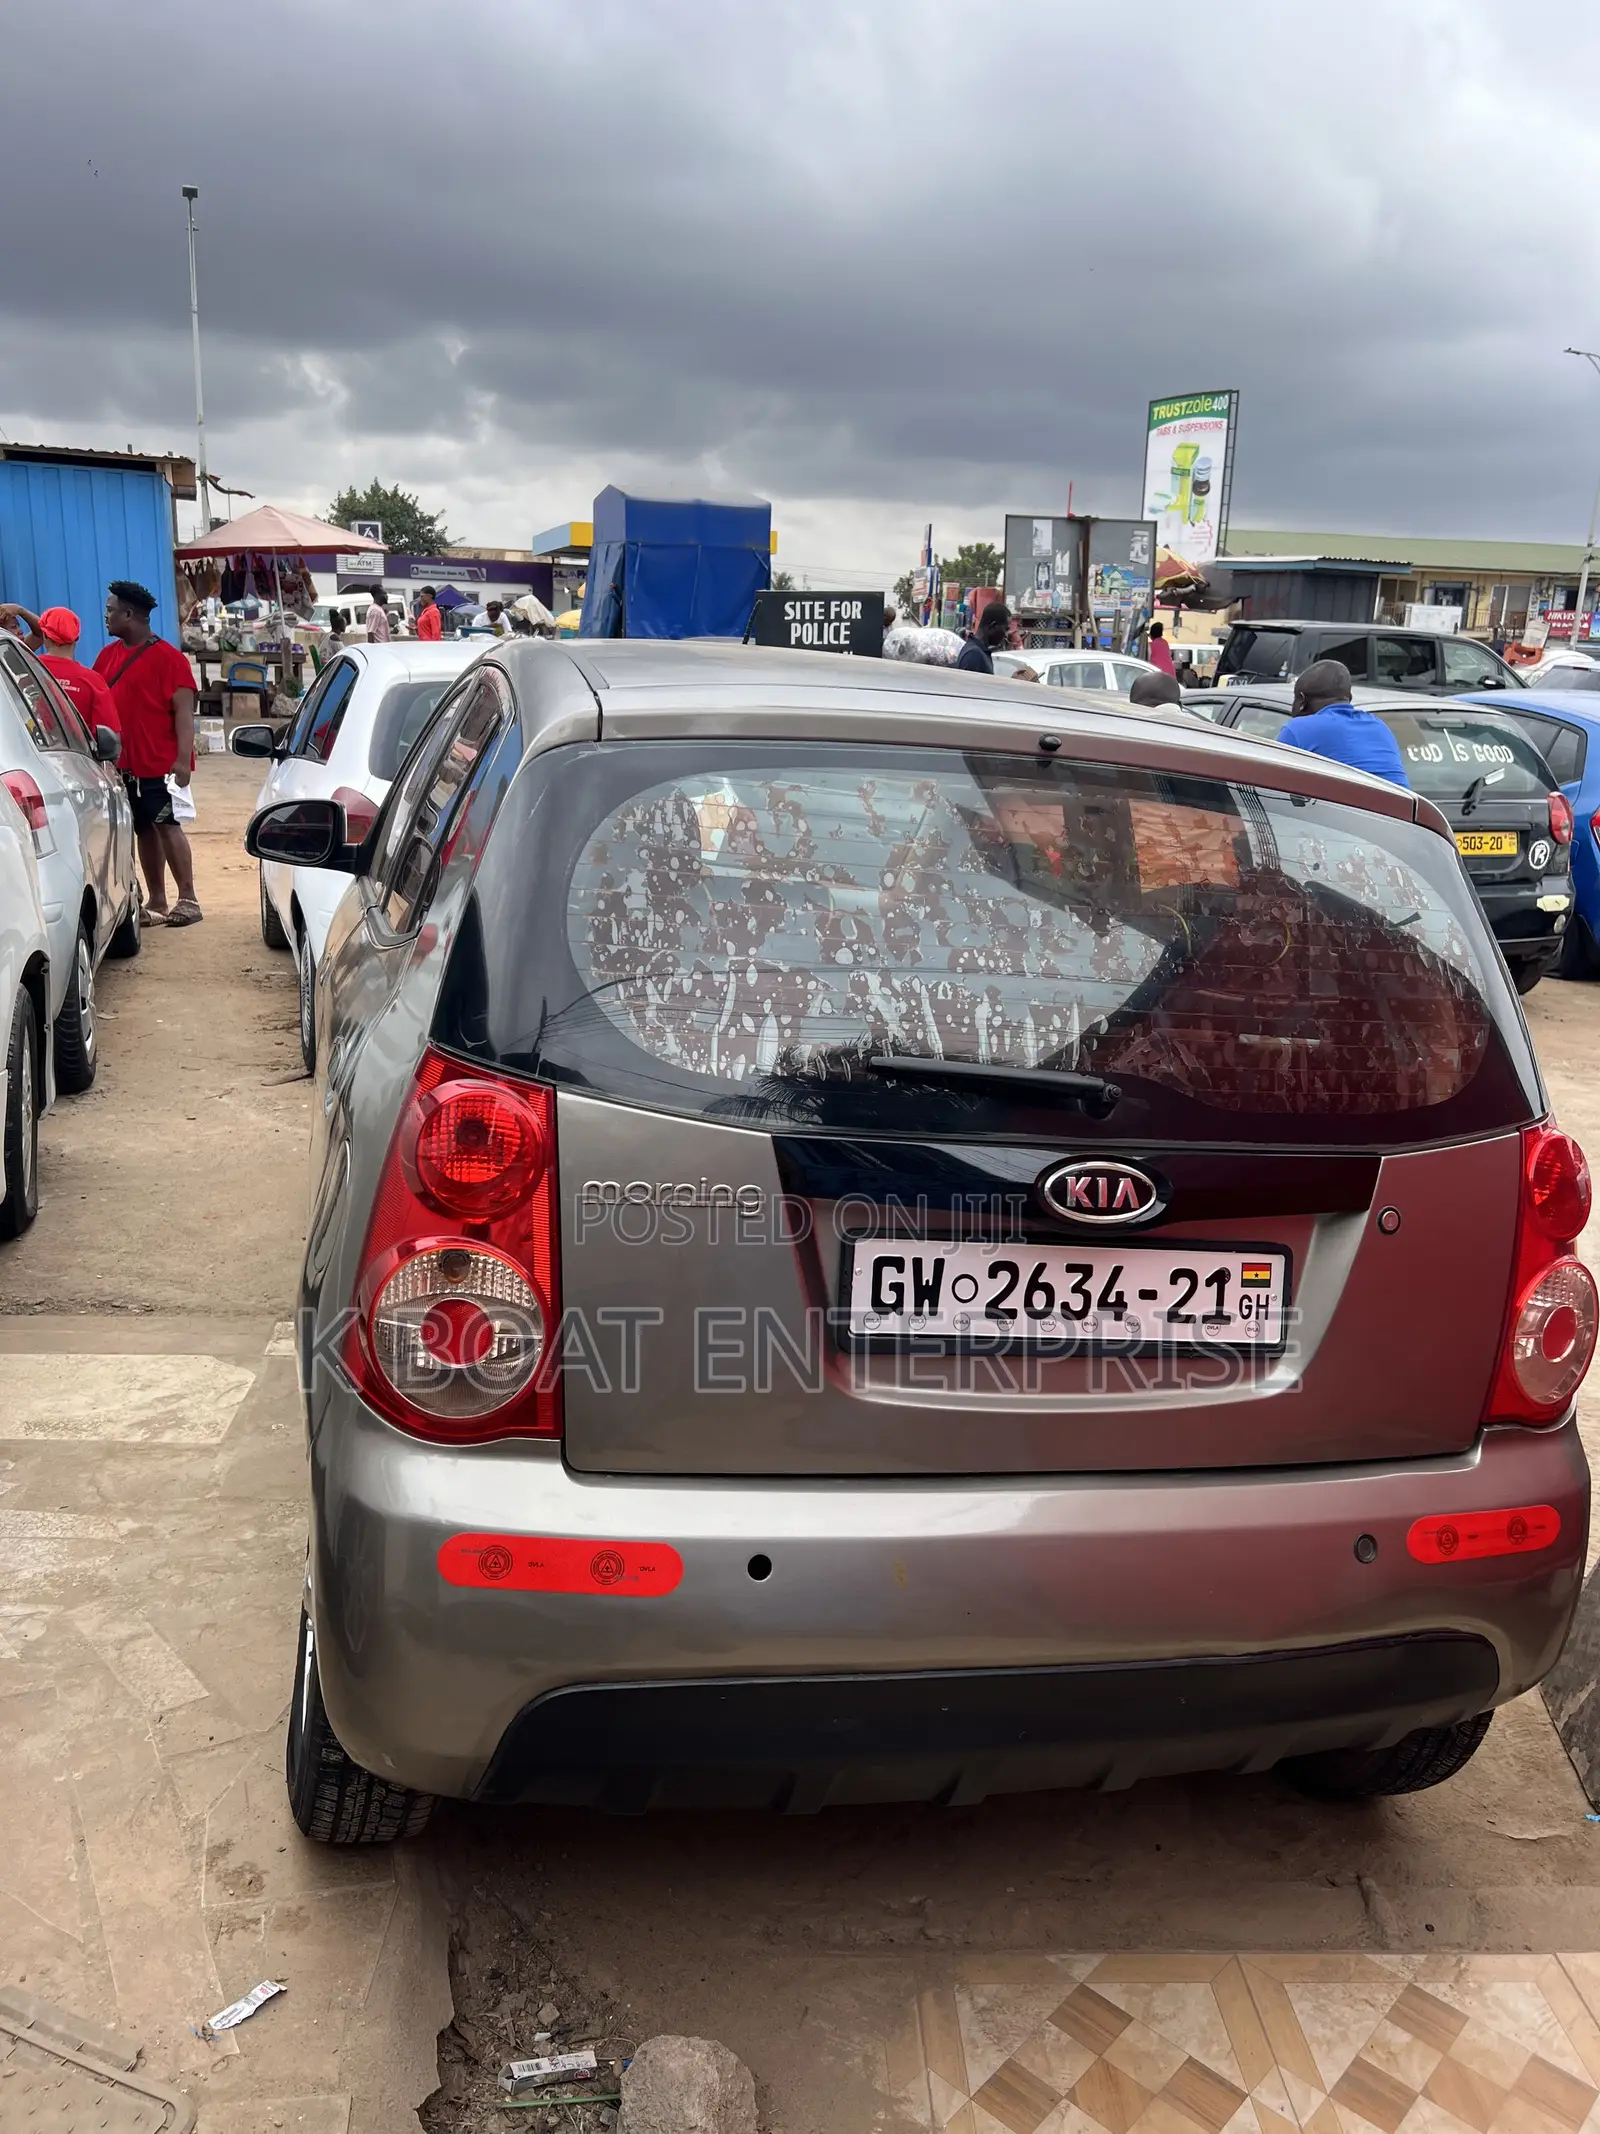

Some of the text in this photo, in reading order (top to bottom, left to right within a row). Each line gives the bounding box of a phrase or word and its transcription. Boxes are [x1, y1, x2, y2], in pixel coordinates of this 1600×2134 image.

[1178, 420, 1224, 433] SUSPENSIONS
[784, 601, 862, 620] SITE FOR
[790, 622, 850, 645] POLICE
[1472, 743, 1514, 763] GOOD
[582, 1177, 763, 1217] morning
[1066, 1176, 1140, 1208] KIA
[870, 1255, 1232, 1326] GW 2634-21
[1238, 1293, 1270, 1321] GH
